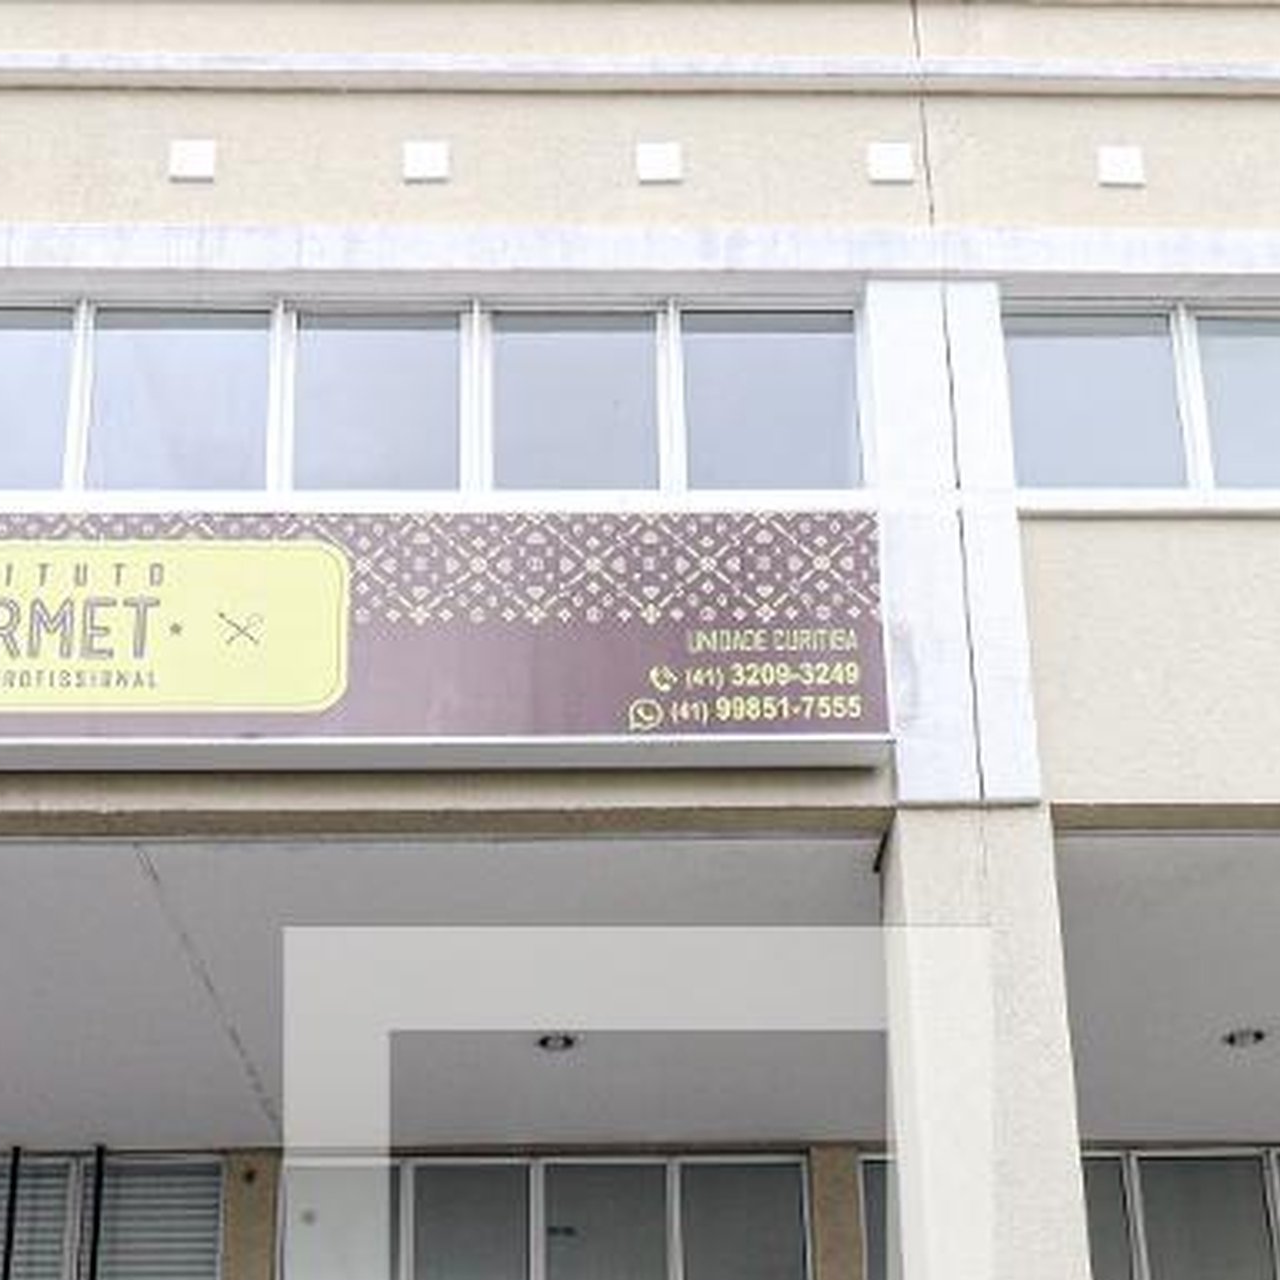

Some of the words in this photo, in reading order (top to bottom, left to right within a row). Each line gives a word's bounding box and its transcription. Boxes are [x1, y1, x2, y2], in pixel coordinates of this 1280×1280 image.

[689, 629, 768, 653] UNIDADE
[773, 629, 859, 651] CURITIBA
[685, 667, 724, 691] (41)
[731, 662, 859, 687] 3209-3249
[669, 700, 709, 726] (41)
